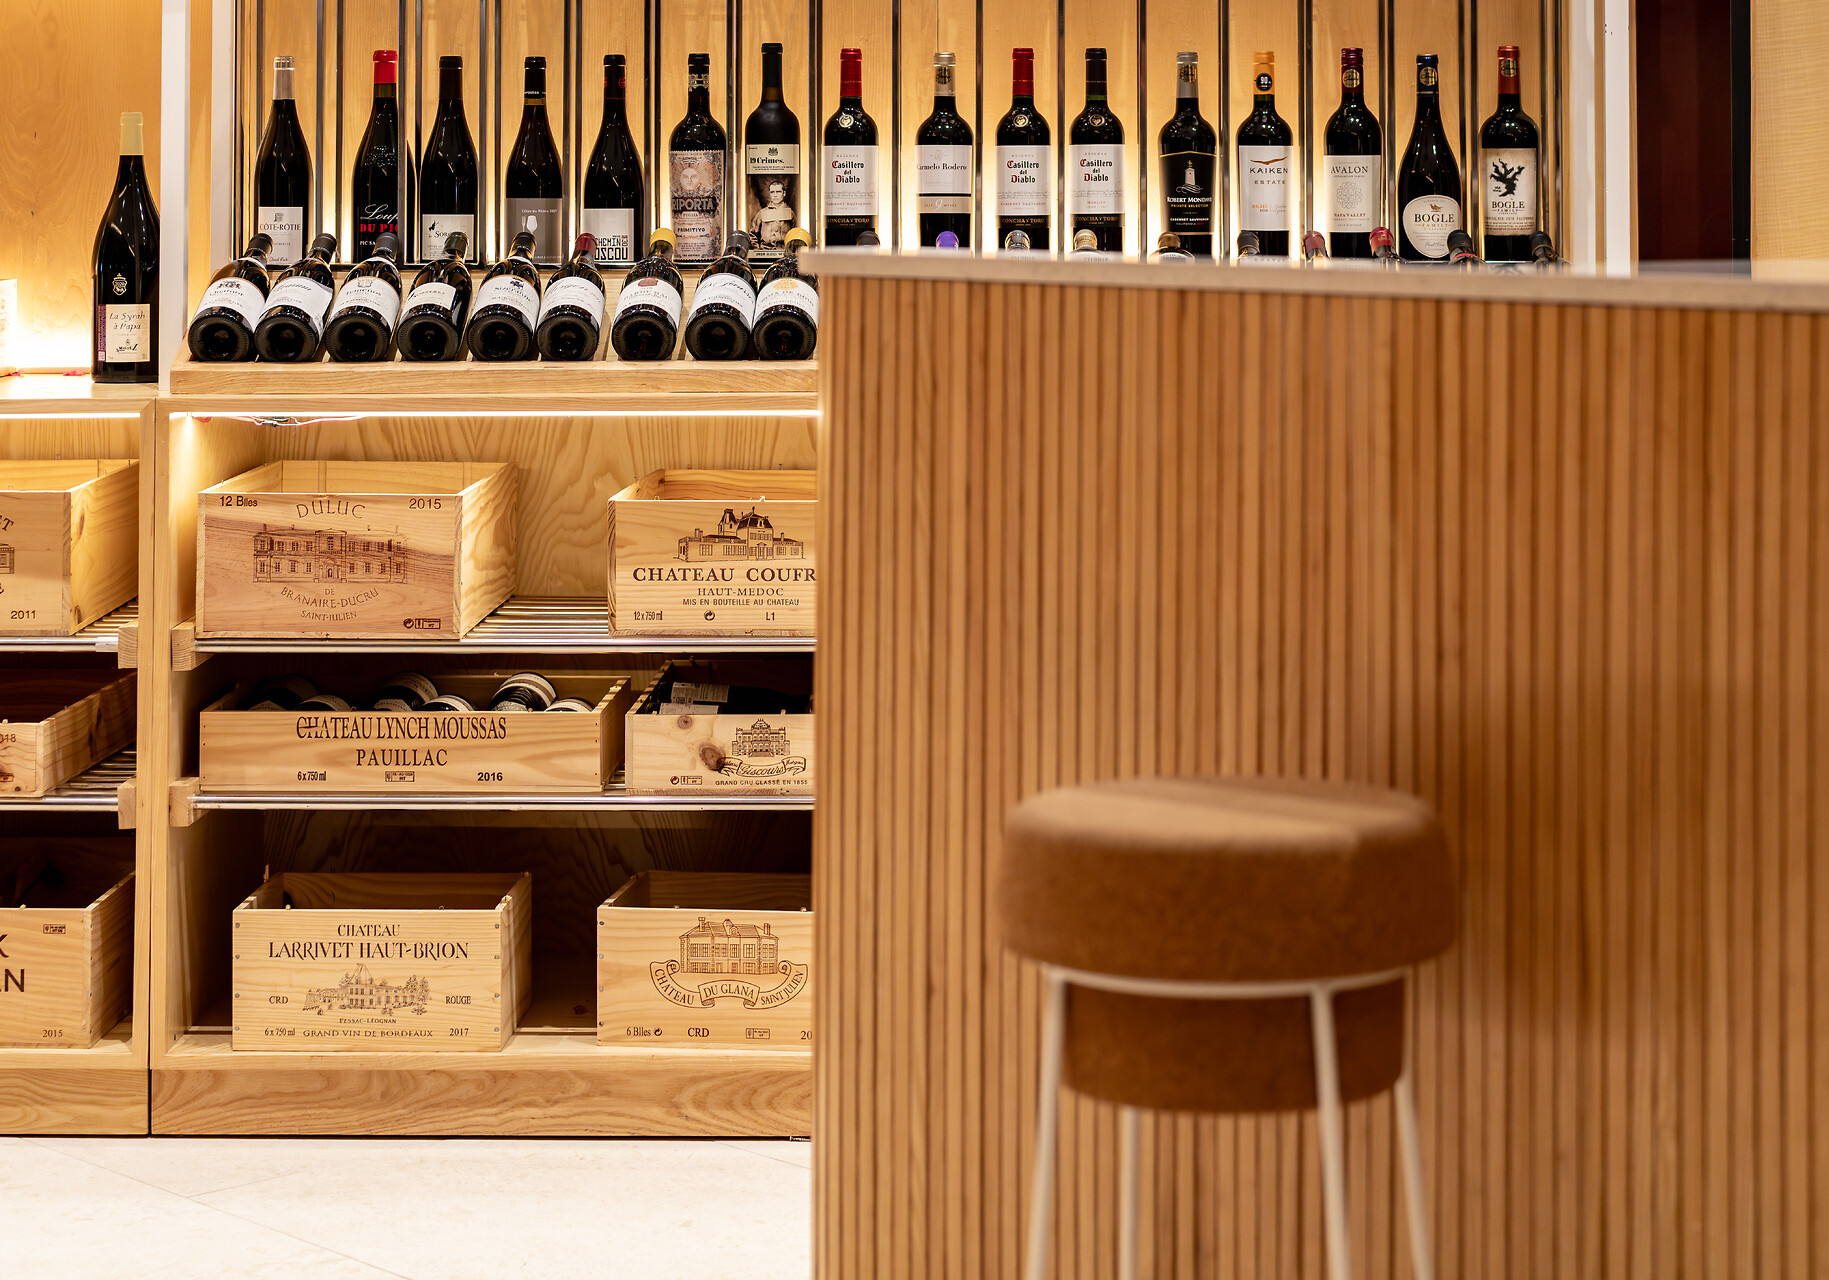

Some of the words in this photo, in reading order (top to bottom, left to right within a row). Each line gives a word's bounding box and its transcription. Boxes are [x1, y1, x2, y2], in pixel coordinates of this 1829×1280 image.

[836, 175, 860, 183] Diablo
[1011, 175, 1036, 183] Diablo
[1084, 173, 1108, 181] Diablo
[1414, 214, 1454, 222] BOGLE
[260, 222, 301, 231] CÔTE-RÔTIE
[360, 224, 376, 232] DU
[120, 323, 141, 332] Papa
[220, 496, 232, 506] 12
[409, 498, 442, 509] 2015
[296, 500, 365, 519] DULUC
[633, 568, 734, 582] CHATEAU
[698, 588, 784, 596] HAUT-MEDOC
[280, 587, 379, 608] BRANAIRE-DUCRU
[11, 610, 36, 619] 2011
[766, 612, 775, 620] L1
[297, 716, 373, 739] CHATEAU
[377, 716, 430, 739] LYNCH
[434, 716, 506, 739] MOUSSAS
[356, 749, 448, 766] PAUILLAC
[740, 765, 784, 775] Giscours
[477, 772, 503, 781] 2016
[338, 924, 400, 936] CHATEAU
[269, 942, 353, 960] LARRIVET
[360, 942, 468, 960] HAUT-BRION
[654, 969, 694, 1005] CHATEAU
[703, 985, 718, 998] DU
[720, 984, 754, 999] GLANA
[760, 994, 783, 1006] SAINT
[783, 971, 804, 998] JULIEN
[269, 996, 288, 1004] CRD
[446, 996, 471, 1004] ROUGE
[43, 1030, 63, 1038] 2015
[450, 1028, 468, 1036] 2017
[627, 1027, 631, 1036] 6
[688, 1028, 709, 1037] CRD
